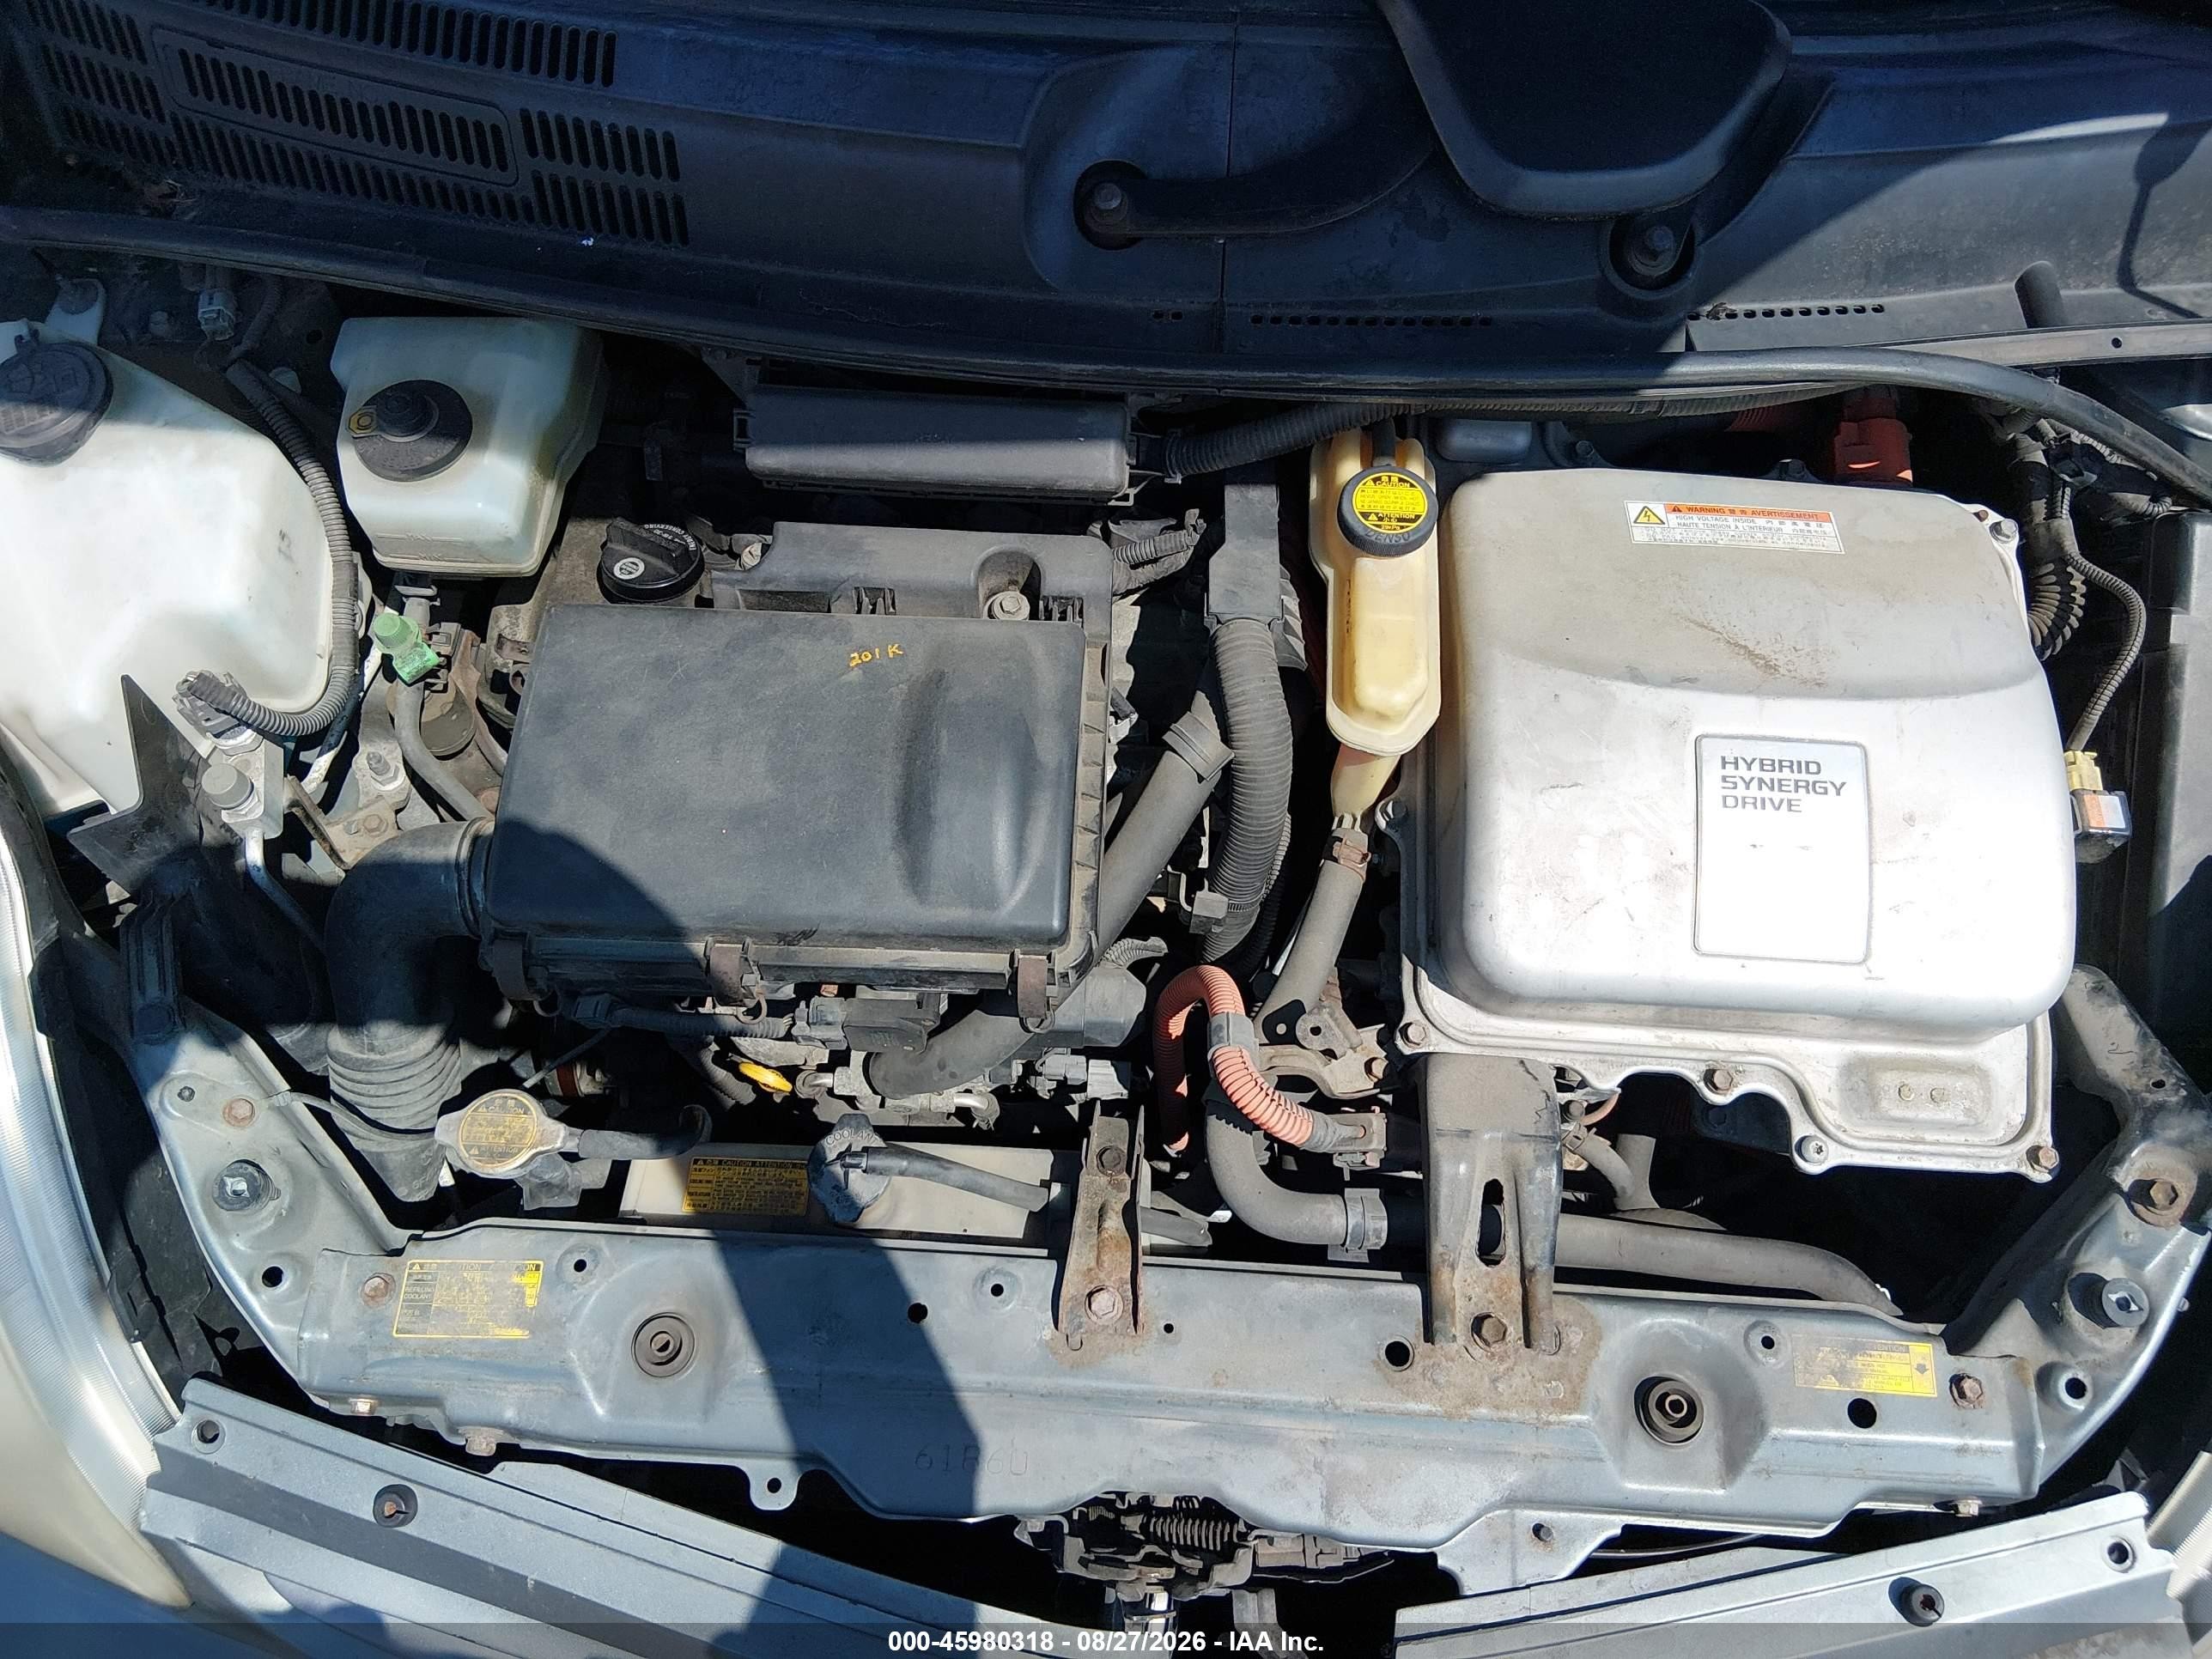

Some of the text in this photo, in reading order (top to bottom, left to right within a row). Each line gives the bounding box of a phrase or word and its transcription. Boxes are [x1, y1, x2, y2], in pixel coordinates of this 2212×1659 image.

[1686, 505, 1726, 514] WARNING
[1751, 509, 1819, 520] AVERTISSEMENT
[644, 523, 685, 535] CONSERVING
[1364, 530, 1410, 544] DENSO
[1720, 755, 1821, 775] HYBRID
[1721, 775, 1847, 796] SYNERGY
[1721, 794, 1802, 813] DRIVE
[825, 1127, 880, 1146] COOLANT
